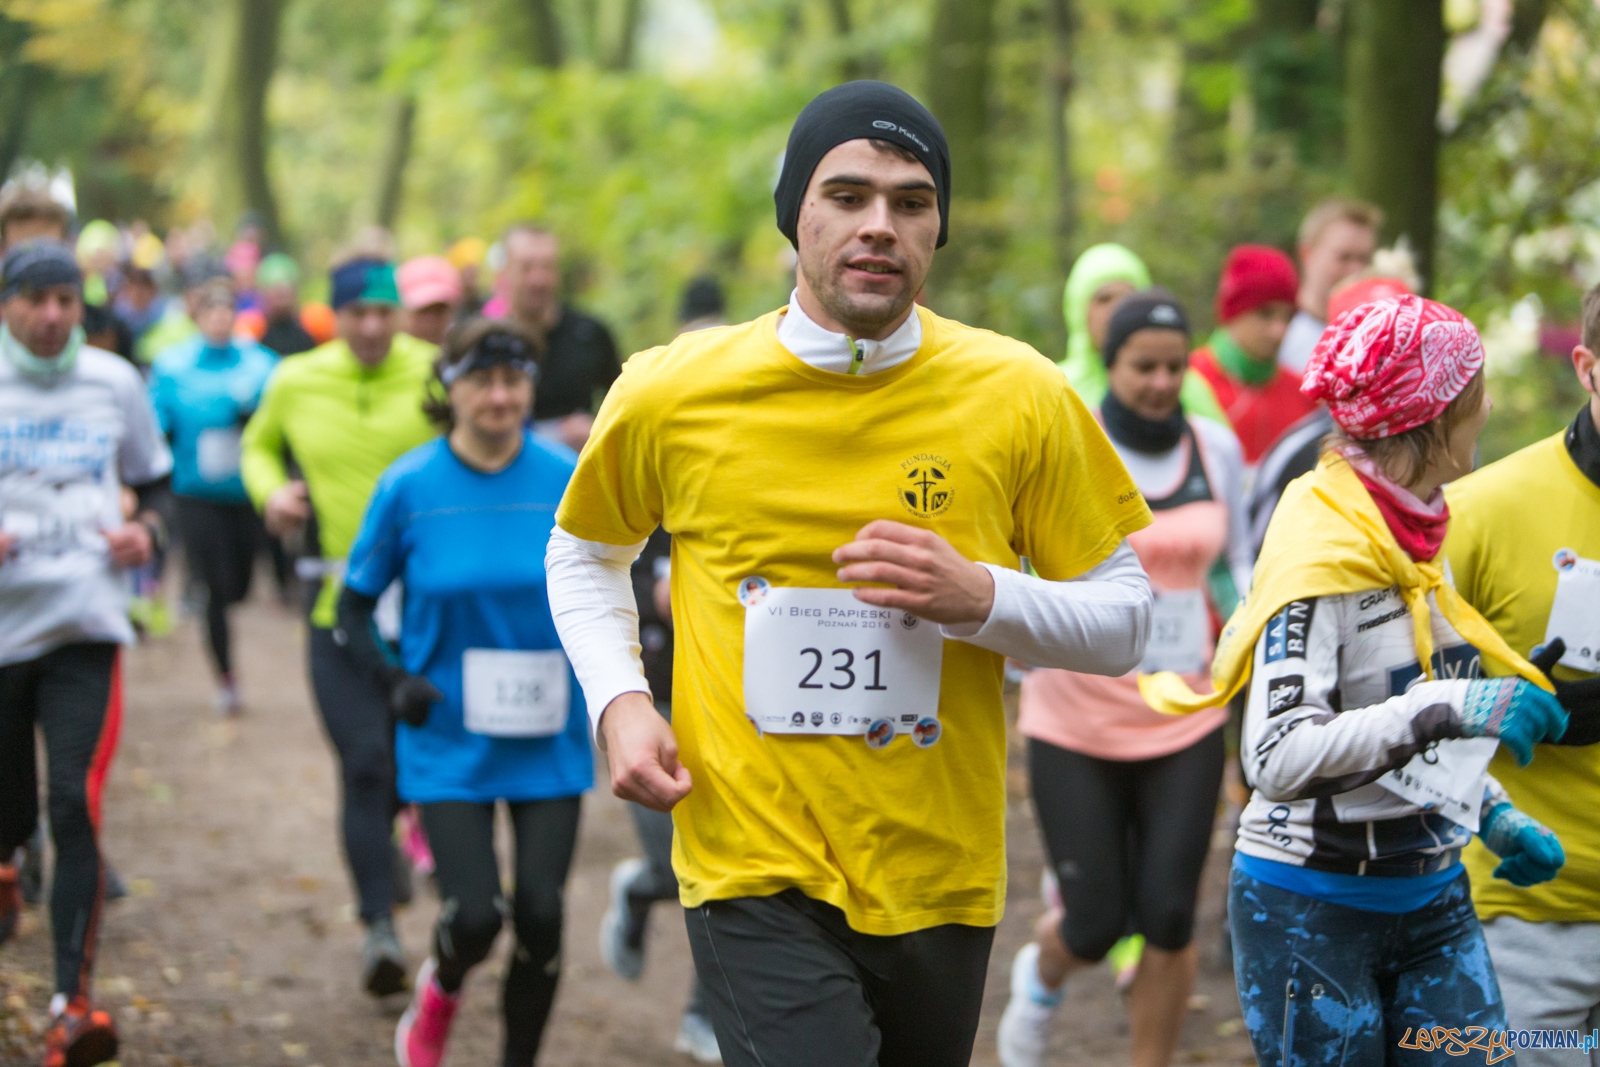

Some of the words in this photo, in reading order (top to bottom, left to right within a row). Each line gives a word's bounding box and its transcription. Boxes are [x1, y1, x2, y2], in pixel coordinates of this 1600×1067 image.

[900, 453, 952, 471] FUNDACJA
[767, 606, 783, 617] VI
[789, 606, 822, 618] BIEG
[828, 606, 891, 620] PAPIESKI
[862, 620, 891, 630] 2016
[798, 647, 888, 691] 231
